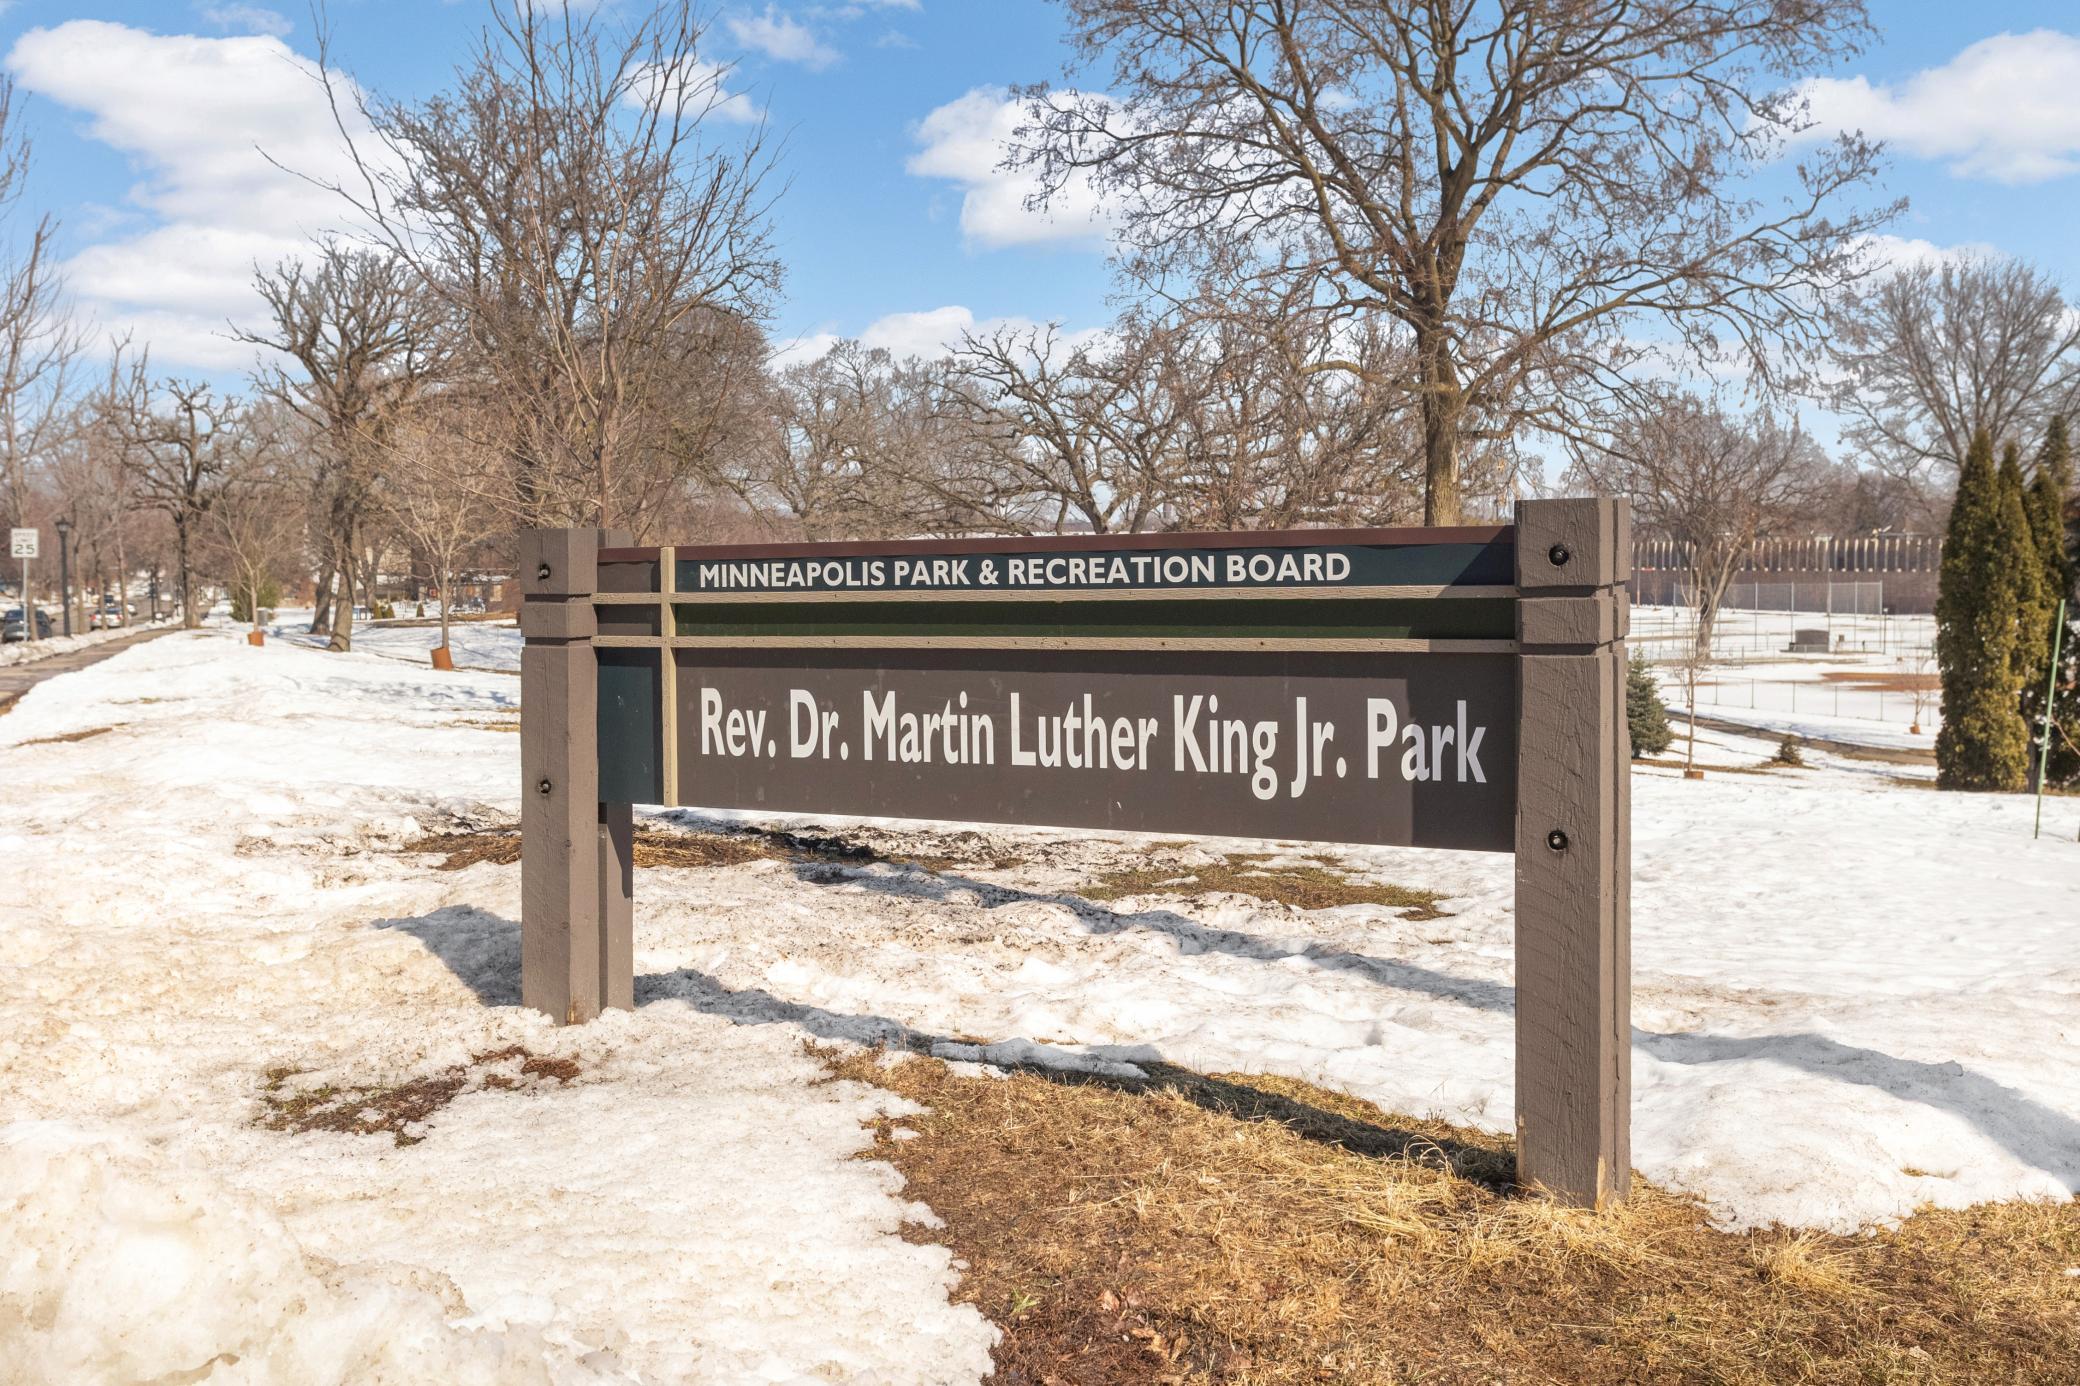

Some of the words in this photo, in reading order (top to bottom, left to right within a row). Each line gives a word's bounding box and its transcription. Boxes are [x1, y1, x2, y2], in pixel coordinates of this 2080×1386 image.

[14, 544, 35, 554] 25
[699, 561, 886, 588] MINNEAPOLIS
[894, 560, 971, 586] PARK
[978, 559, 999, 585] &
[1008, 555, 1215, 585] RECREATION
[1226, 553, 1351, 582] BOARD
[700, 687, 777, 759] Rev.
[789, 688, 849, 761] Dr.
[863, 689, 995, 766] Martin
[1010, 691, 1159, 771] Luther
[1173, 694, 1279, 801] King
[1290, 696, 1348, 799] Jr.
[1366, 697, 1487, 783] Park
